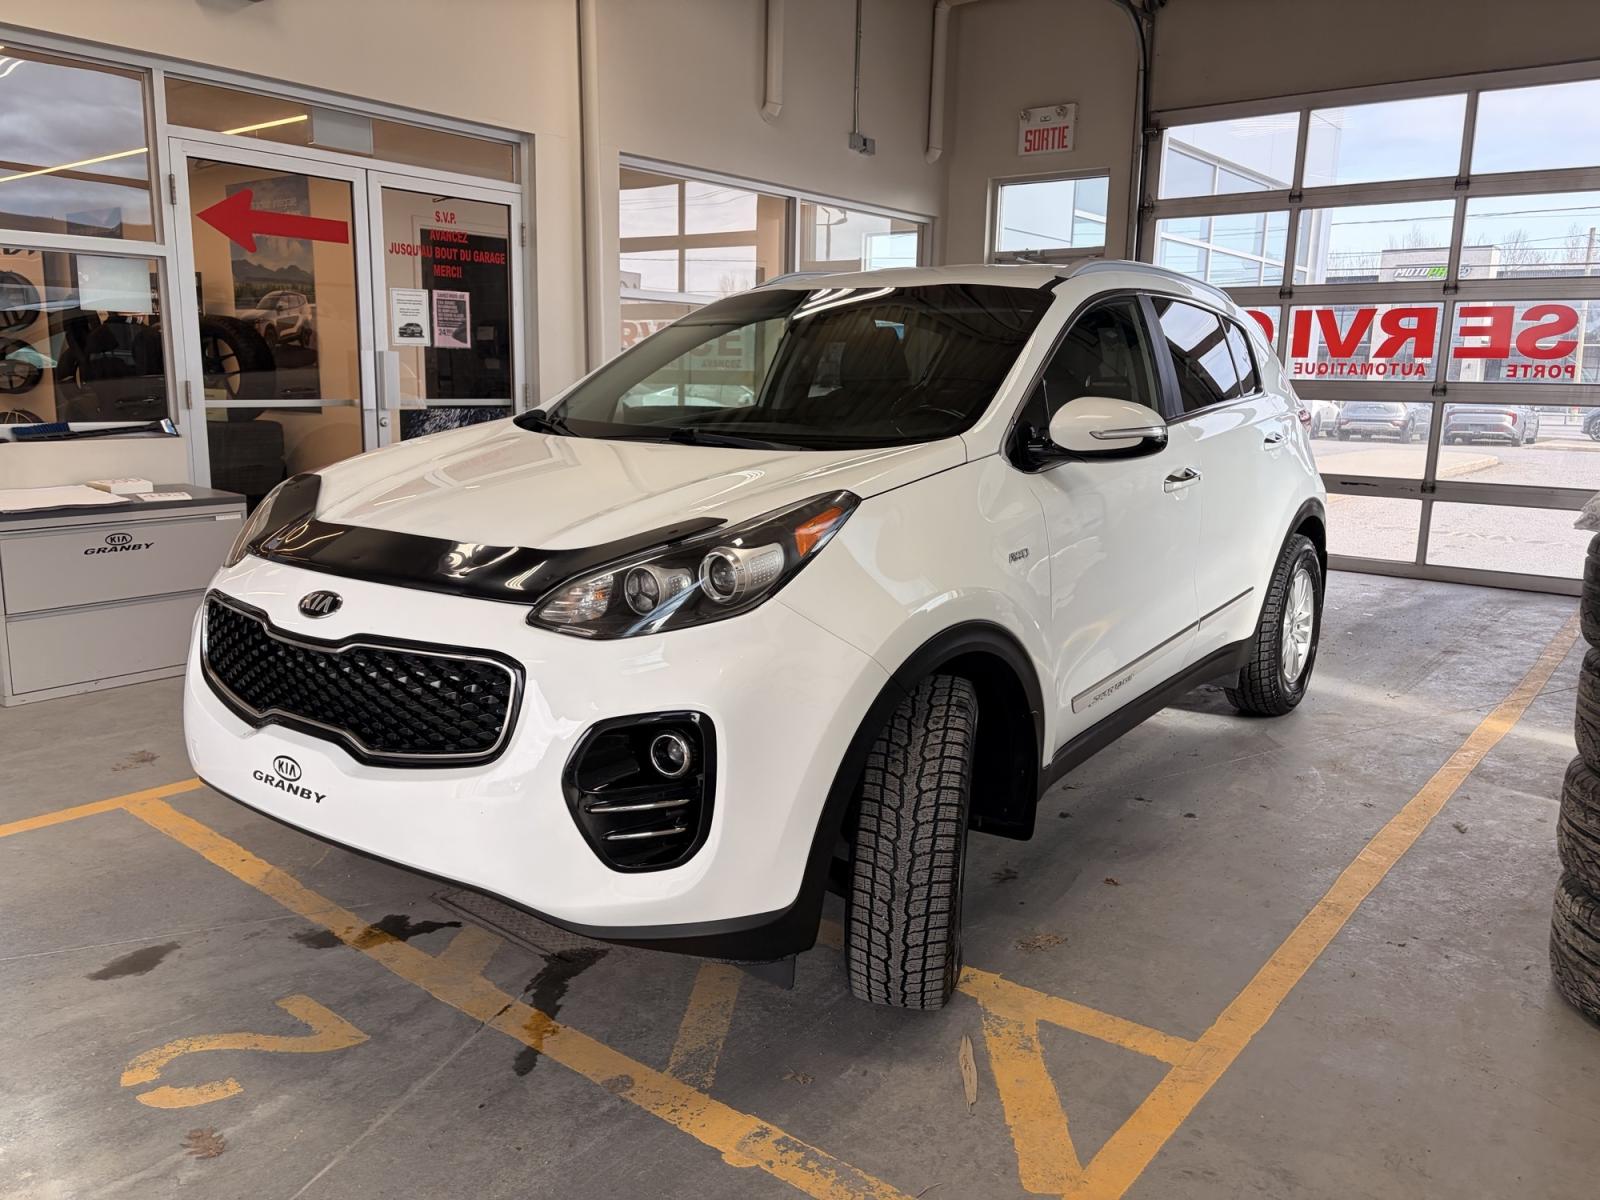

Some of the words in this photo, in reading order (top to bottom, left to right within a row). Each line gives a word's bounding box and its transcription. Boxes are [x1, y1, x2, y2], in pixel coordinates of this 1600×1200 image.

[1024, 125, 1070, 153] SORTIE
[435, 211, 456, 223] S.V.P.
[430, 230, 468, 243] AVANCEZ
[389, 242, 432, 257] JUSQU'AU
[435, 247, 458, 260] BOUT
[460, 249, 471, 261] DU
[473, 251, 505, 264] GARAGE
[83, 542, 155, 556] GRANBY
[301, 592, 334, 613] KIA
[252, 769, 327, 804] GRANBY
